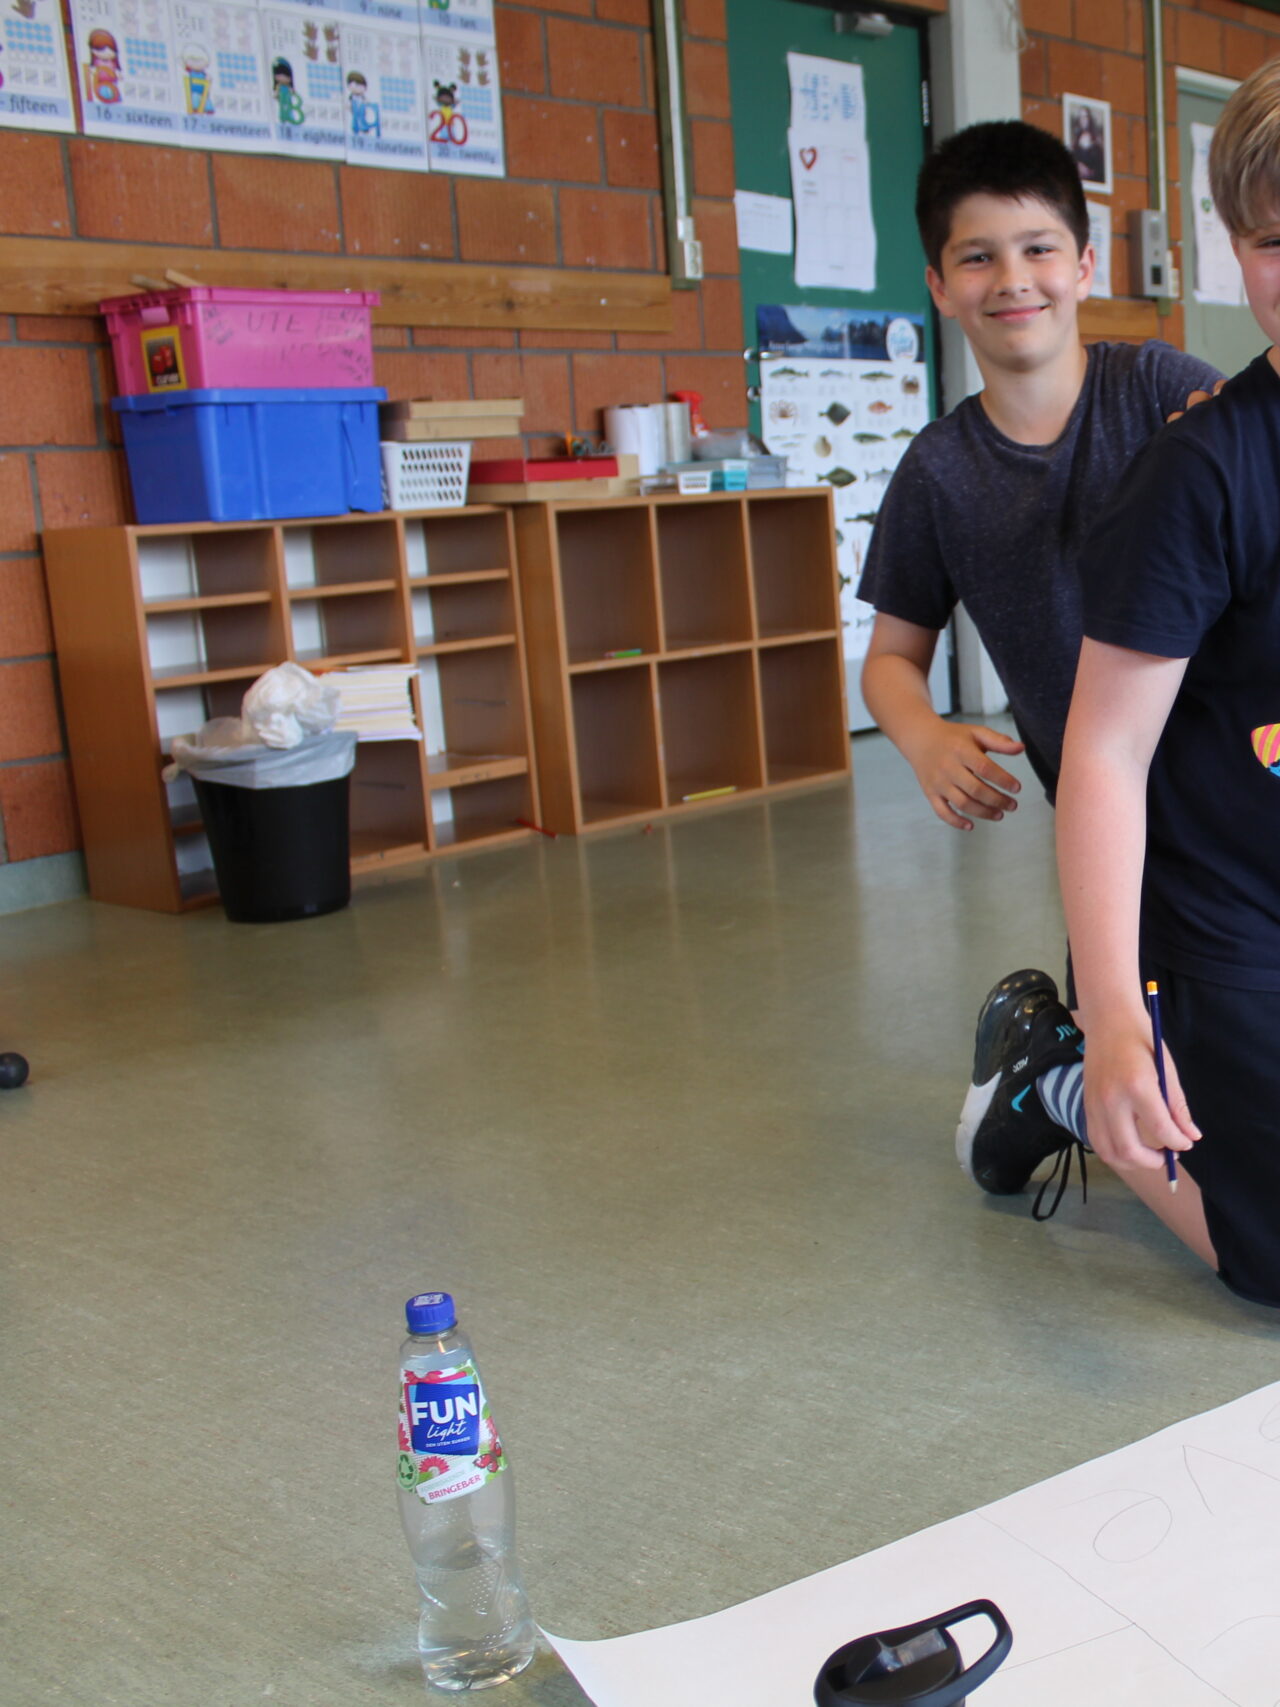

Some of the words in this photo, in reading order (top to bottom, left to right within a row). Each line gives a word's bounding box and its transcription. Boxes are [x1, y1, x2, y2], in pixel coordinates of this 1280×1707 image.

[459, 18, 476, 30] ten
[9, 95, 58, 114] fifteen
[96, 106, 112, 120] 16
[126, 111, 173, 128] sixteen
[183, 116, 198, 129] 17
[210, 122, 270, 137] seventeen
[428, 110, 469, 145] 20
[303, 131, 345, 146] eightee
[374, 142, 422, 156] nineteen
[459, 150, 496, 165] twenty
[411, 1392, 478, 1426] FUN
[427, 1420, 467, 1441] light
[428, 1474, 482, 1500] BRINGEBÆR
